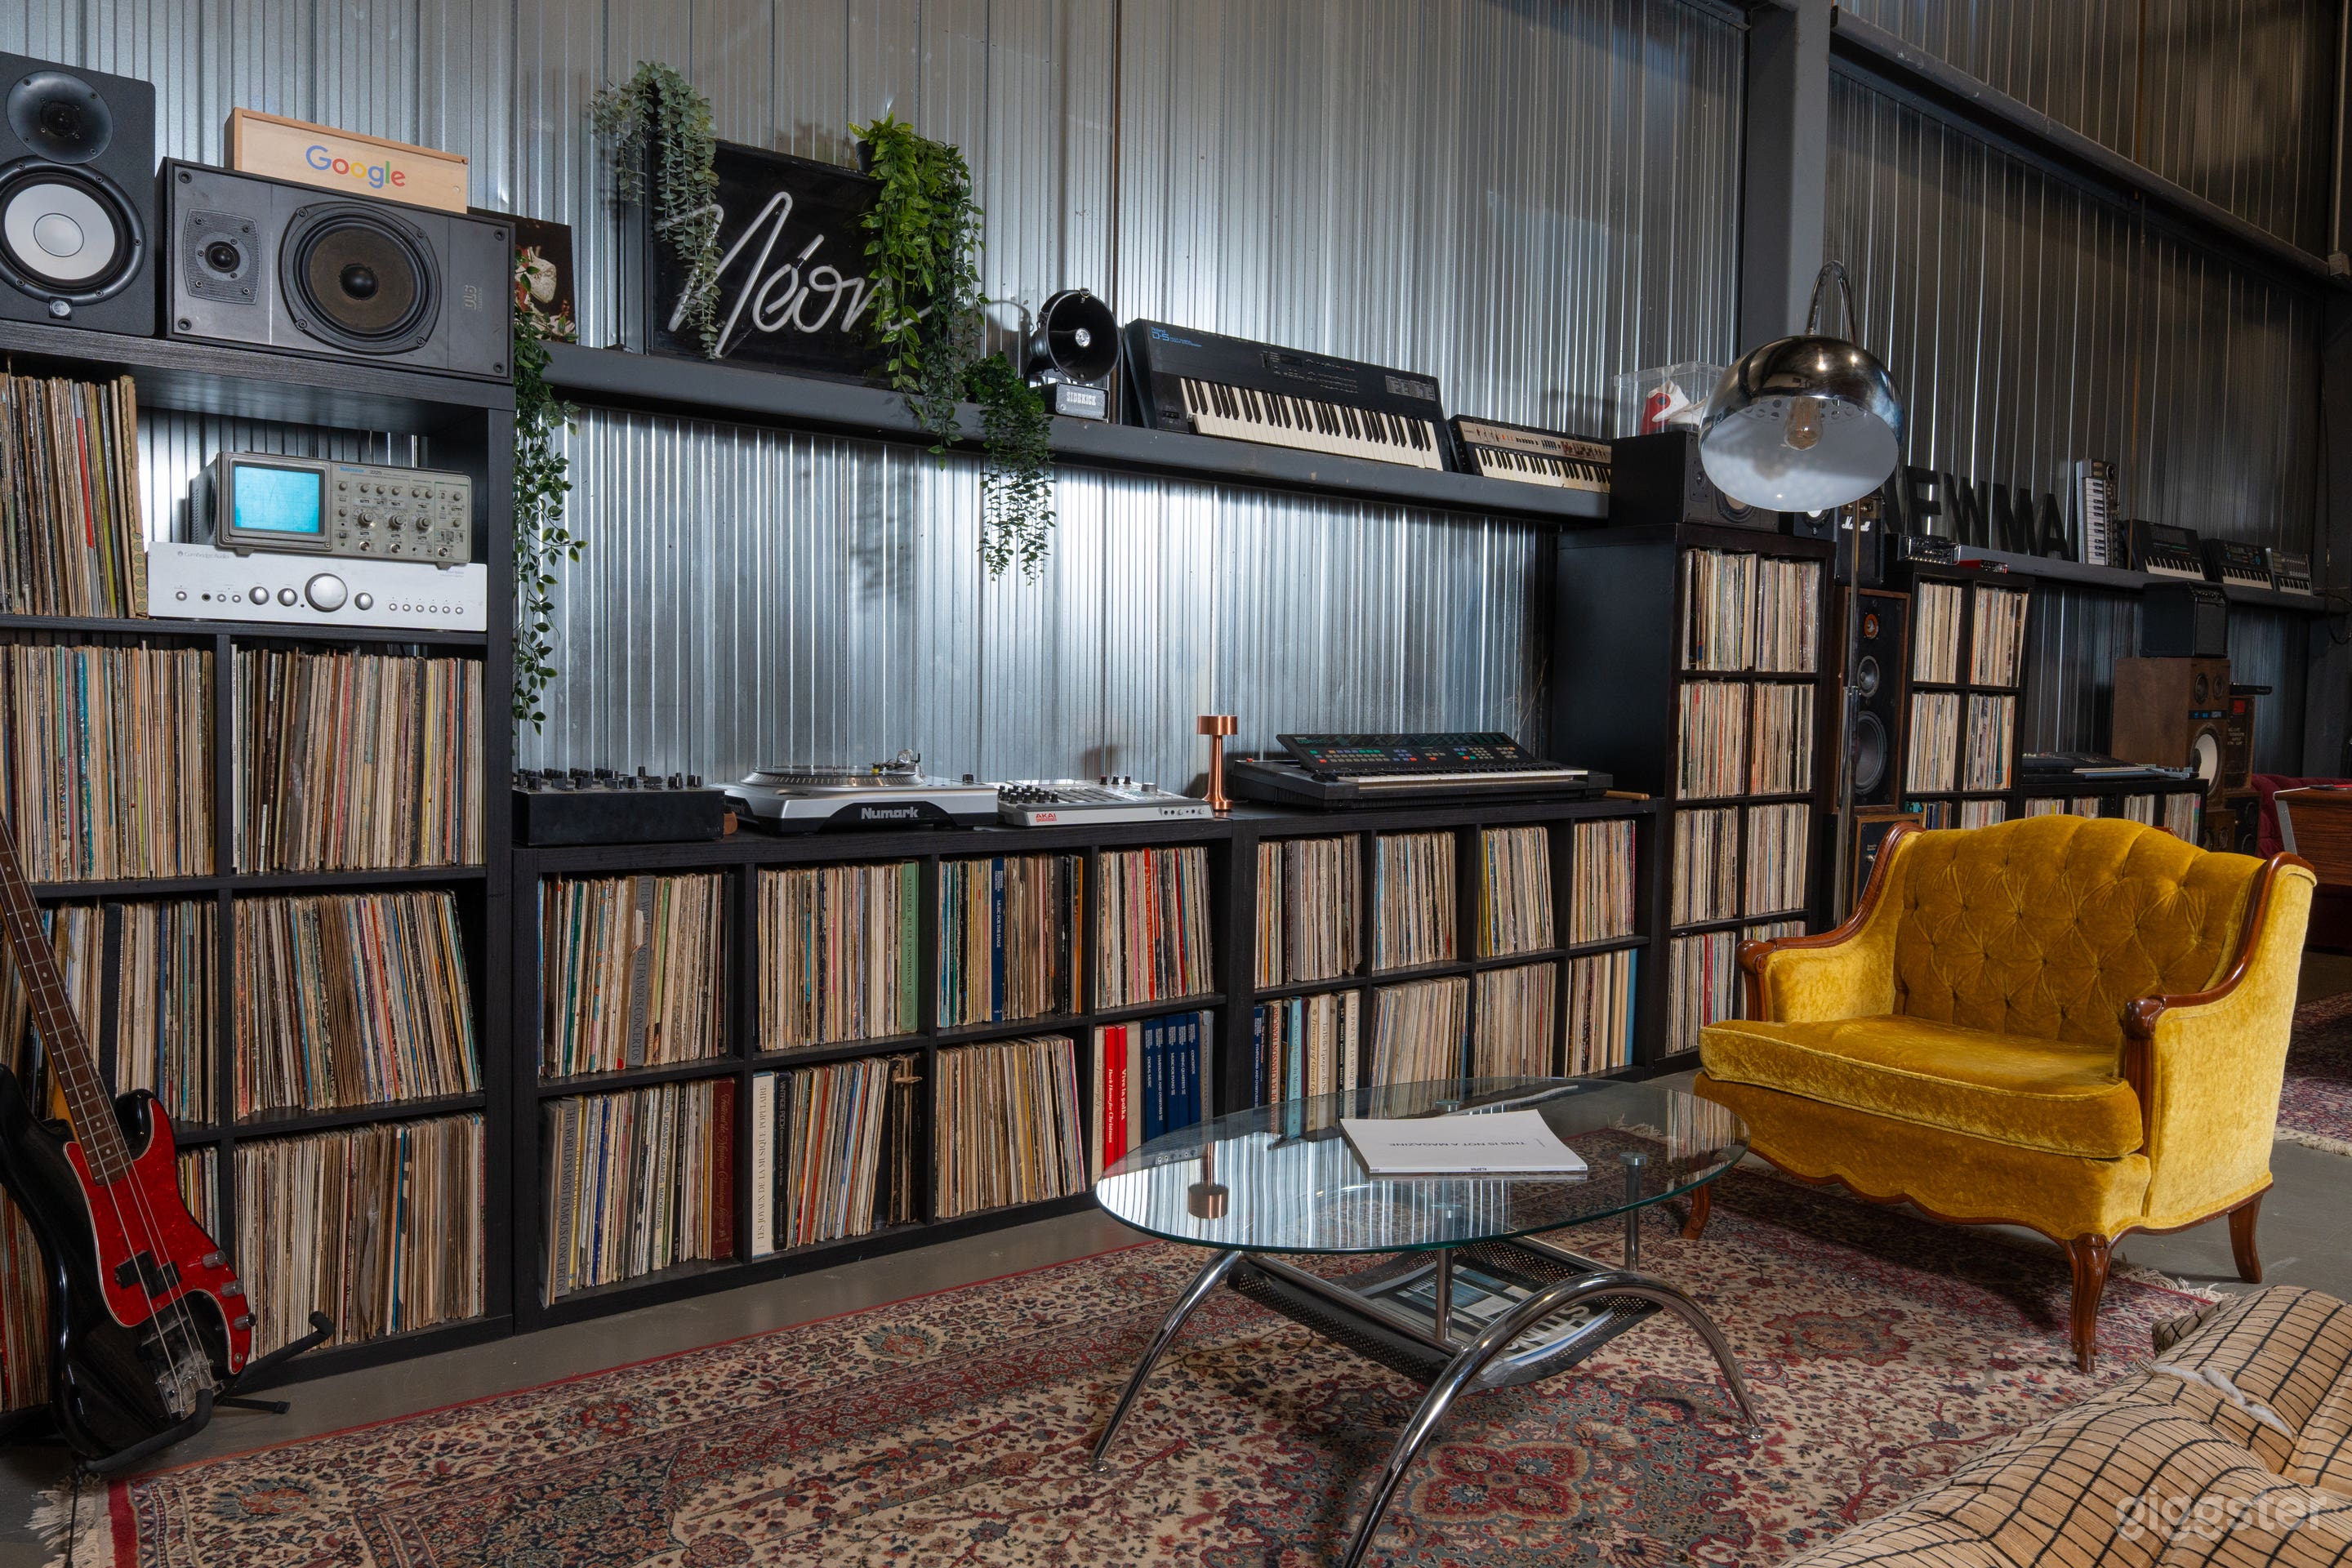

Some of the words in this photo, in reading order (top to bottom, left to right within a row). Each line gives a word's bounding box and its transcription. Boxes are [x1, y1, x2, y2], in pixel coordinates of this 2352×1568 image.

[305, 145, 406, 189] Google
[1066, 390, 1097, 407] SIDEKICK
[861, 806, 919, 820] Numark
[641, 881, 651, 898] THE
[637, 942, 648, 969] MOST
[635, 969, 646, 1007] FAMOUS
[632, 1008, 644, 1060] CONCERTOS
[1271, 1092, 1277, 1102] DE
[1272, 1081, 1277, 1090] LA
[565, 1106, 576, 1125] THE
[759, 1085, 767, 1129] POPULAIRE
[563, 1126, 575, 1169] WORLD'S
[659, 1138, 668, 1184] MACCABAEUS
[758, 1132, 767, 1168] MUSIQUE
[561, 1169, 572, 1195] MOST
[758, 1168, 766, 1180] LA
[758, 1182, 765, 1193] DE
[559, 1196, 571, 1235] FAMOUS
[656, 1187, 665, 1230] MACKERRAS
[757, 1194, 766, 1224] JOYAUX
[757, 1226, 765, 1240] LES
[556, 1236, 568, 1292] CONCERTOS
